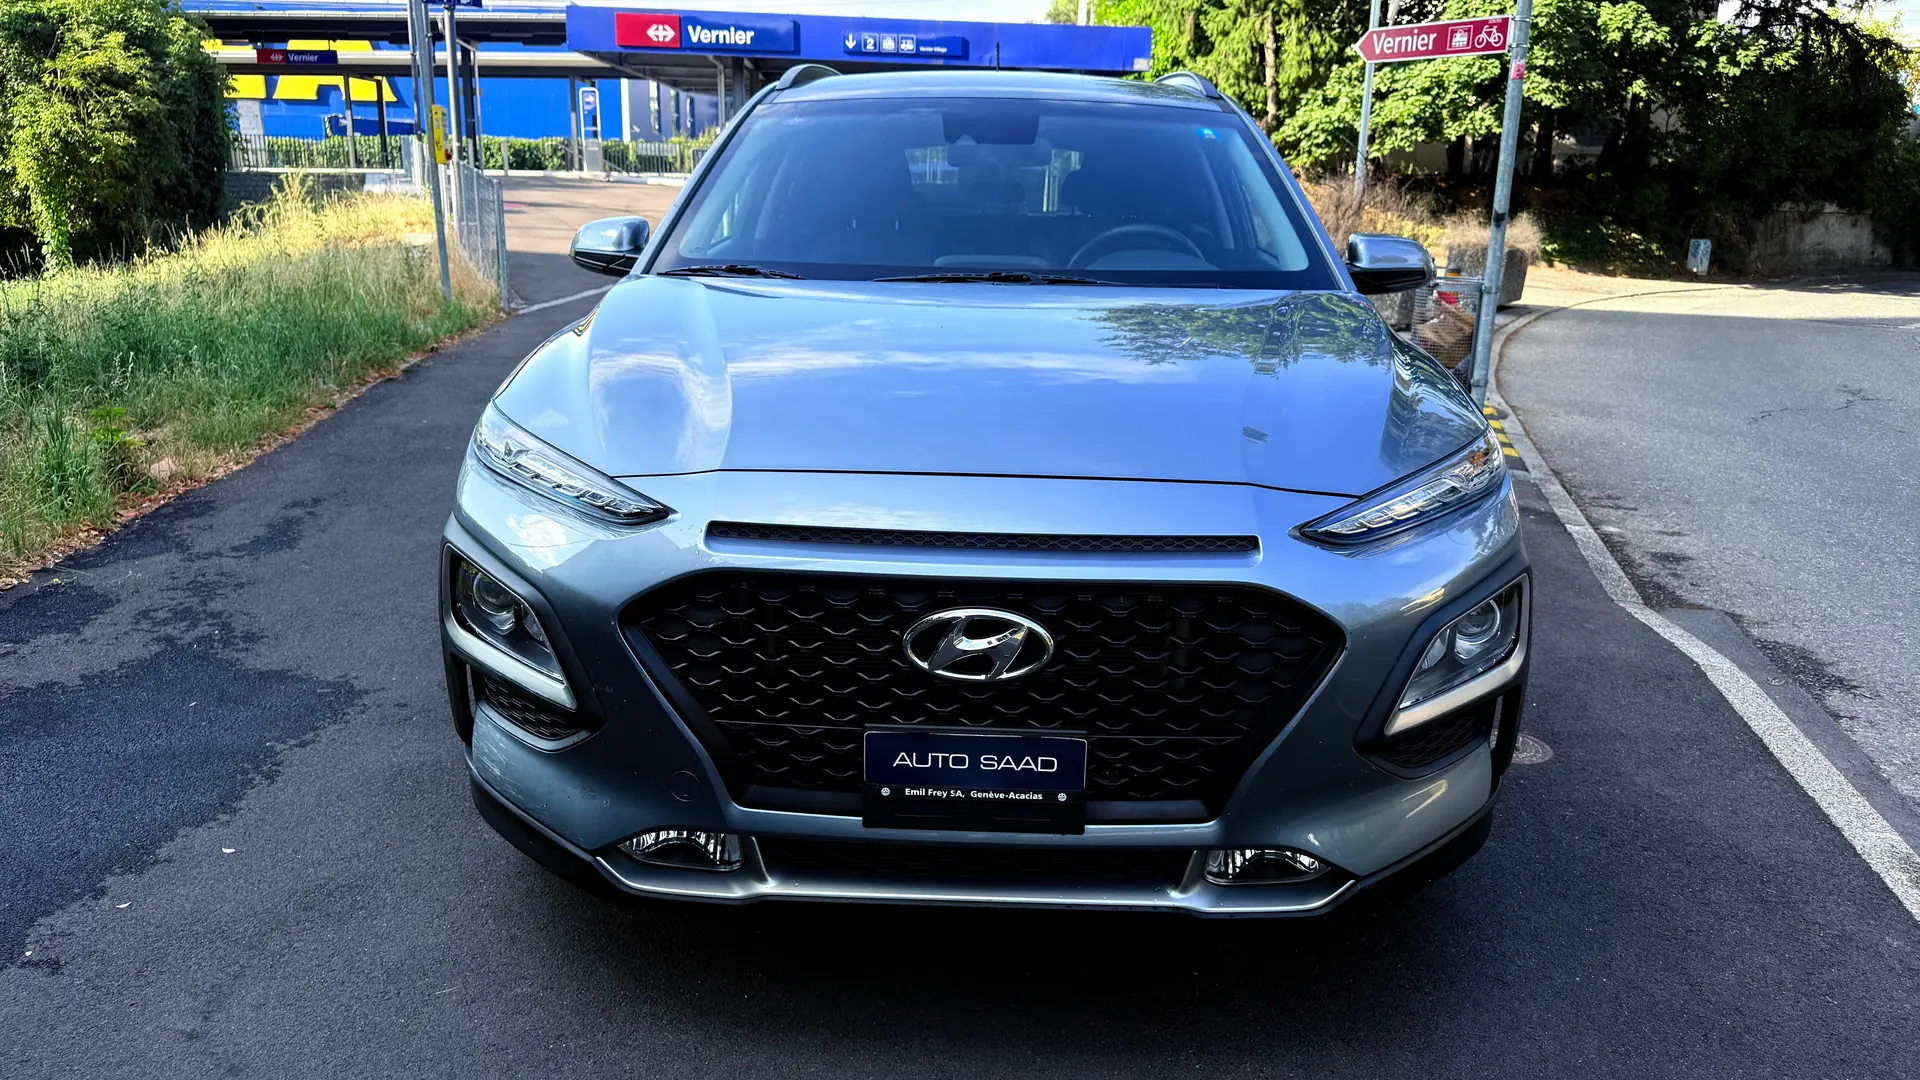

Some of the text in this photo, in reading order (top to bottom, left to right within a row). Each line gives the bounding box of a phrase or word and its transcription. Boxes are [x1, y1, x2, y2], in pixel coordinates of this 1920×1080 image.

[687, 24, 755, 45] Vernier
[1372, 28, 1438, 55] Vernier
[866, 37, 875, 50] 2
[288, 52, 319, 62] Vernier
[892, 752, 1058, 772] AUTO SAAD
[905, 788, 1043, 801] Emil Frey SA, Genève-Acacias
